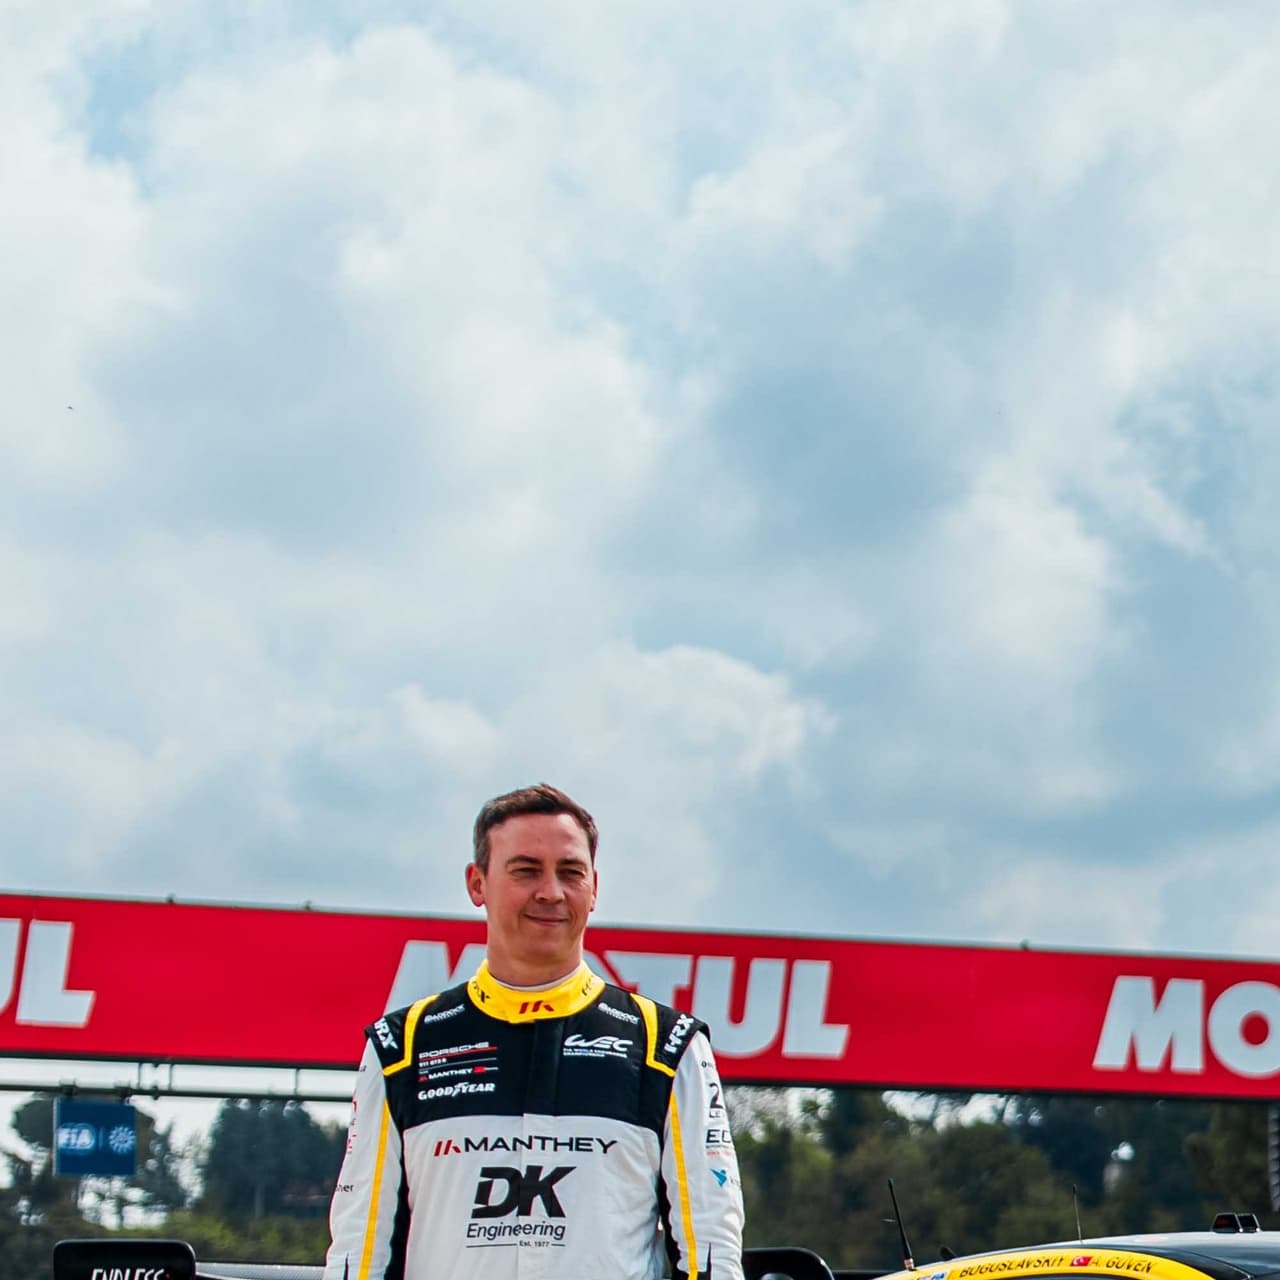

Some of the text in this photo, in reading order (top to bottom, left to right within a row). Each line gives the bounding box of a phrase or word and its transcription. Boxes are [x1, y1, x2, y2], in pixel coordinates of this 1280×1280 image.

[564, 1033, 634, 1053] WEC
[664, 1013, 695, 1055] HRX
[418, 1041, 490, 1059] PORSCHE
[428, 1068, 473, 1080] MANTHEY
[417, 1081, 496, 1101] GOODYEAR
[464, 1135, 618, 1154] MANTHEY
[470, 1164, 577, 1219] DK
[466, 1220, 566, 1241] Engineering
